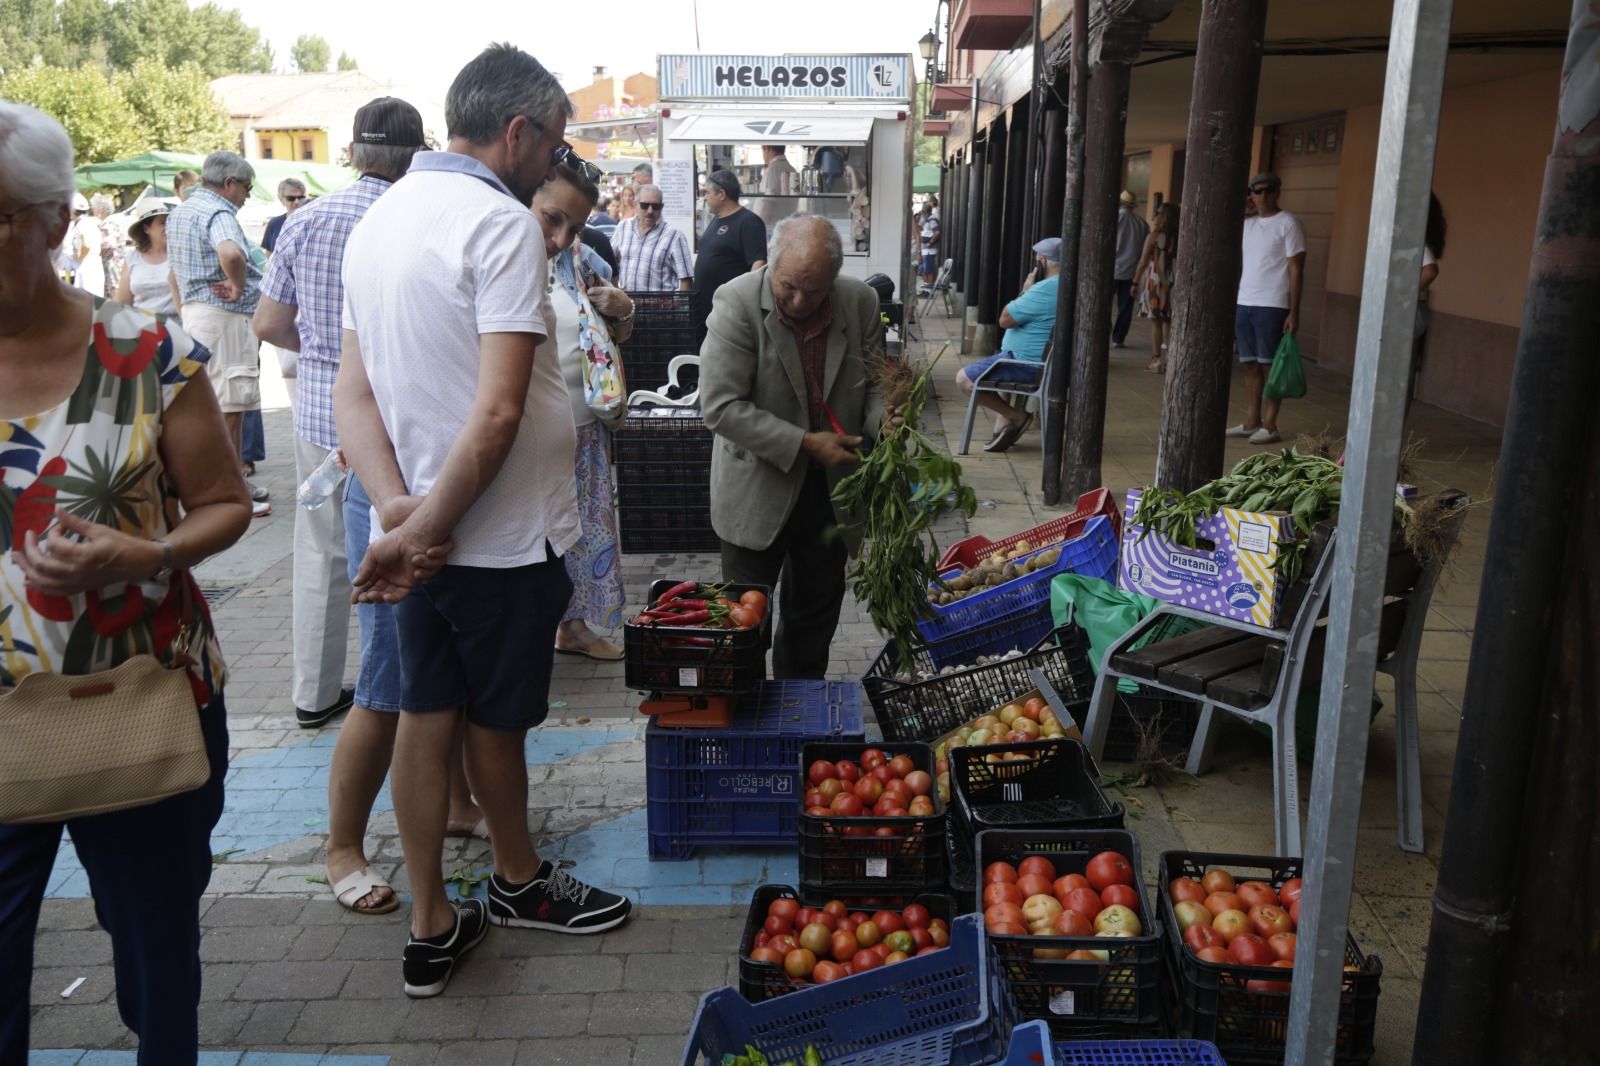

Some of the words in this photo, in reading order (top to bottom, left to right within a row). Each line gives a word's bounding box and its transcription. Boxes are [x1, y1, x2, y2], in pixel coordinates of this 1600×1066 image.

[715, 65, 847, 88] HELAZOS
[1172, 555, 1215, 573] Platania
[719, 777, 771, 787] REBOLLO
